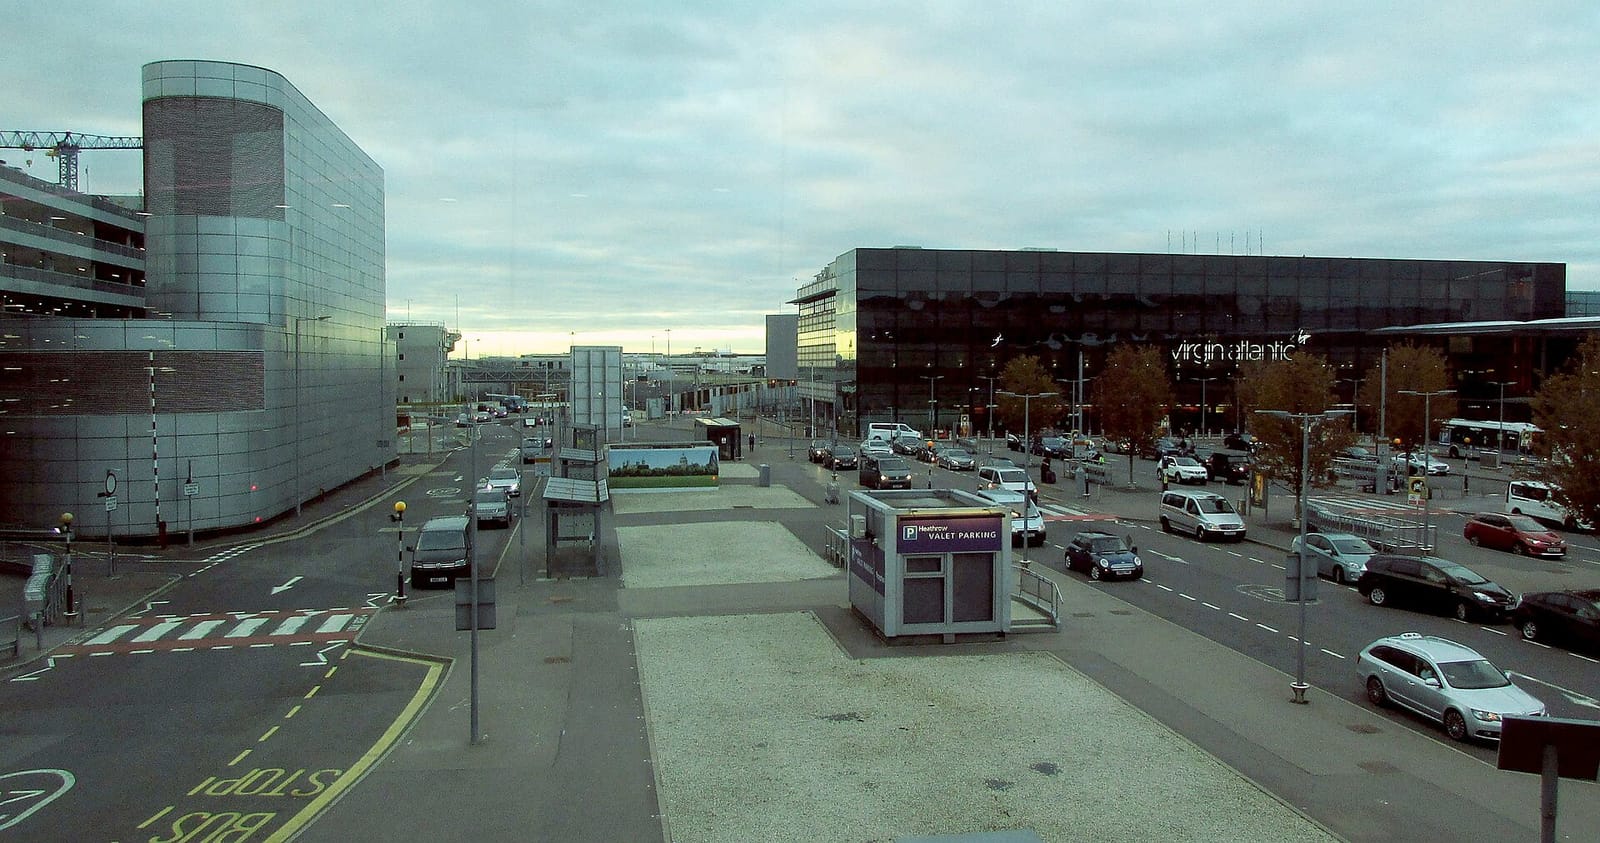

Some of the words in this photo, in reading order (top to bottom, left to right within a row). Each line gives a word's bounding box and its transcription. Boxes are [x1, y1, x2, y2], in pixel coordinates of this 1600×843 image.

[1171, 340, 1224, 365] virgin
[1228, 340, 1296, 361] atlantic
[918, 525, 948, 533] Heathrow
[928, 532, 956, 540] VALET
[958, 531, 997, 539] PARKING
[204, 768, 343, 796] STOP
[149, 811, 277, 843] BUS
